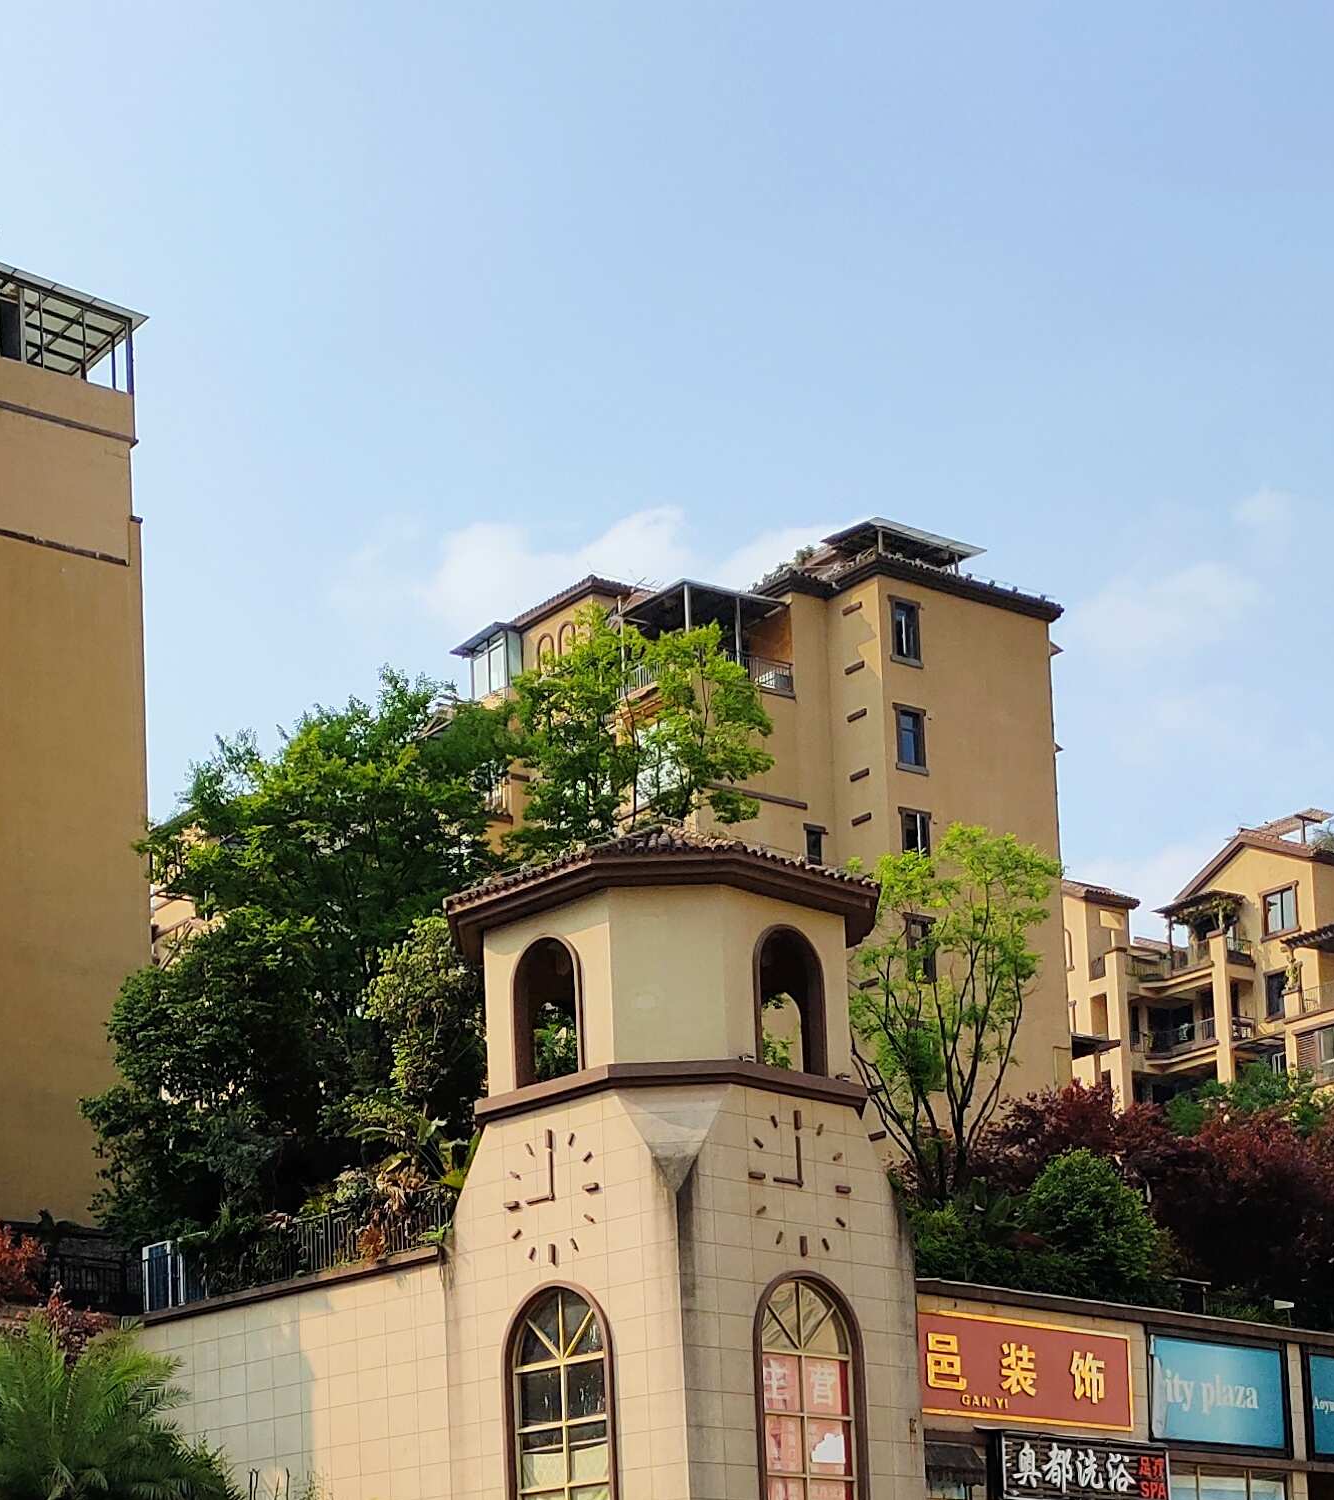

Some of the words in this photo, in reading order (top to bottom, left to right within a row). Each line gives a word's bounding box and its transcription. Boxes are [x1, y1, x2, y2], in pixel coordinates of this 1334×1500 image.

[961, 1394, 991, 1408] GAN
[995, 1398, 1009, 1409] YI
[1201, 1374, 1259, 1415] plaza
[1012, 1440, 1136, 1494] 奥都洗浴
[1140, 1481, 1167, 1499] SPA
